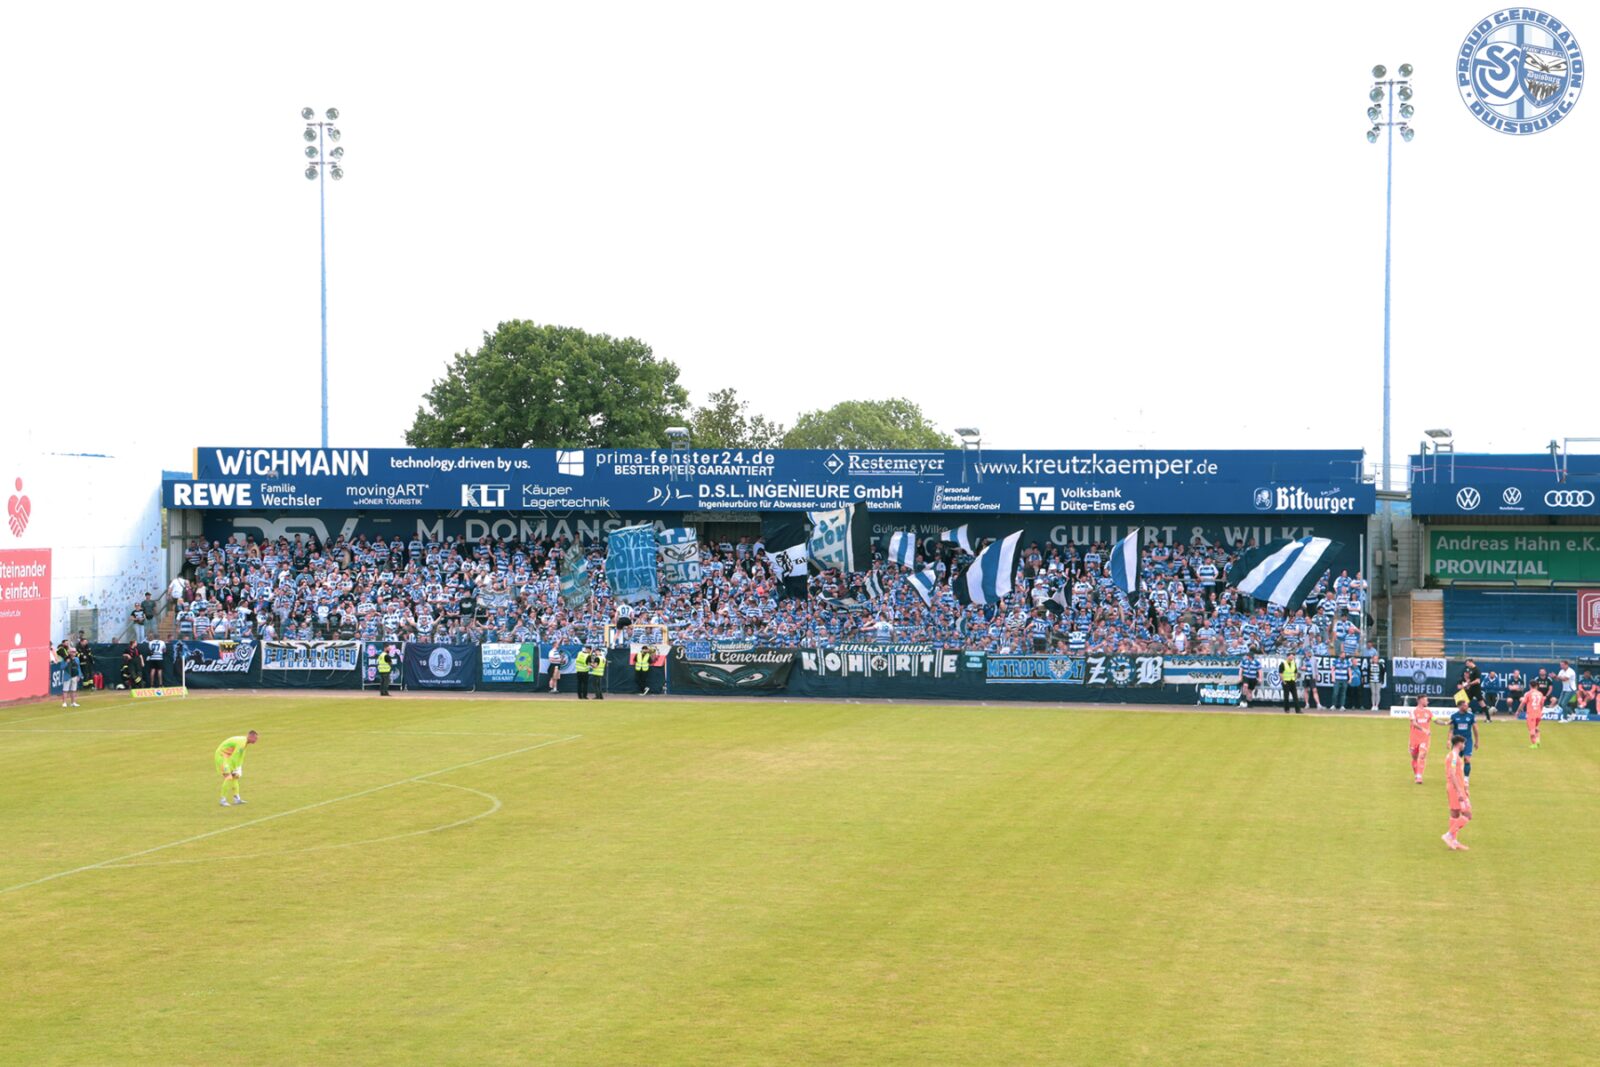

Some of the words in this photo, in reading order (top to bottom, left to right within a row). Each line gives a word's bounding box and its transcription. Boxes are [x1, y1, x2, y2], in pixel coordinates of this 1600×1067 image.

[497, 456, 512, 472] by
[515, 460, 530, 469] us.
[596, 451, 774, 466] prima-fenster24.de
[848, 454, 944, 472] Restemeyer
[974, 452, 1218, 479] www.kreutzkaemper.de
[614, 466, 659, 475] BESTER
[662, 466, 696, 475] PREIS
[698, 466, 774, 476] GARANTIERT
[174, 483, 252, 506] REWE
[261, 484, 296, 493] Familie
[462, 484, 510, 507] KLT
[522, 484, 572, 497] Käuper
[699, 484, 744, 498] D.S.L.
[748, 484, 850, 498] INGENIEURE
[854, 485, 902, 498] GmbH
[1061, 488, 1121, 498] Volksbank
[261, 494, 322, 507] Wechsler
[522, 497, 610, 509] Lagertechnik
[698, 500, 758, 509] Ingenieurbüro
[760, 500, 771, 508] für
[773, 500, 818, 509] Abwasser-
[820, 500, 836, 509] und
[934, 503, 979, 511] Münsterland
[1061, 501, 1116, 512] Düte-Ems
[1119, 502, 1135, 512] eG
[1275, 486, 1356, 514] Bitburger
[417, 519, 454, 542] M.
[1436, 536, 1508, 550] Andreas
[1515, 537, 1560, 551] Hahn
[1566, 538, 1600, 551] e.K.
[1436, 560, 1548, 575] PROVINZIAL
[6, 581, 40, 600] einfach.
[264, 648, 356, 665] COMUNIDAD
[720, 648, 792, 664] Generation
[483, 668, 516, 676] ÜBERALL
[1071, 660, 1085, 678] 47
[1395, 660, 1444, 670] MSV-FANS
[1395, 684, 1442, 694] HOCHFELD
